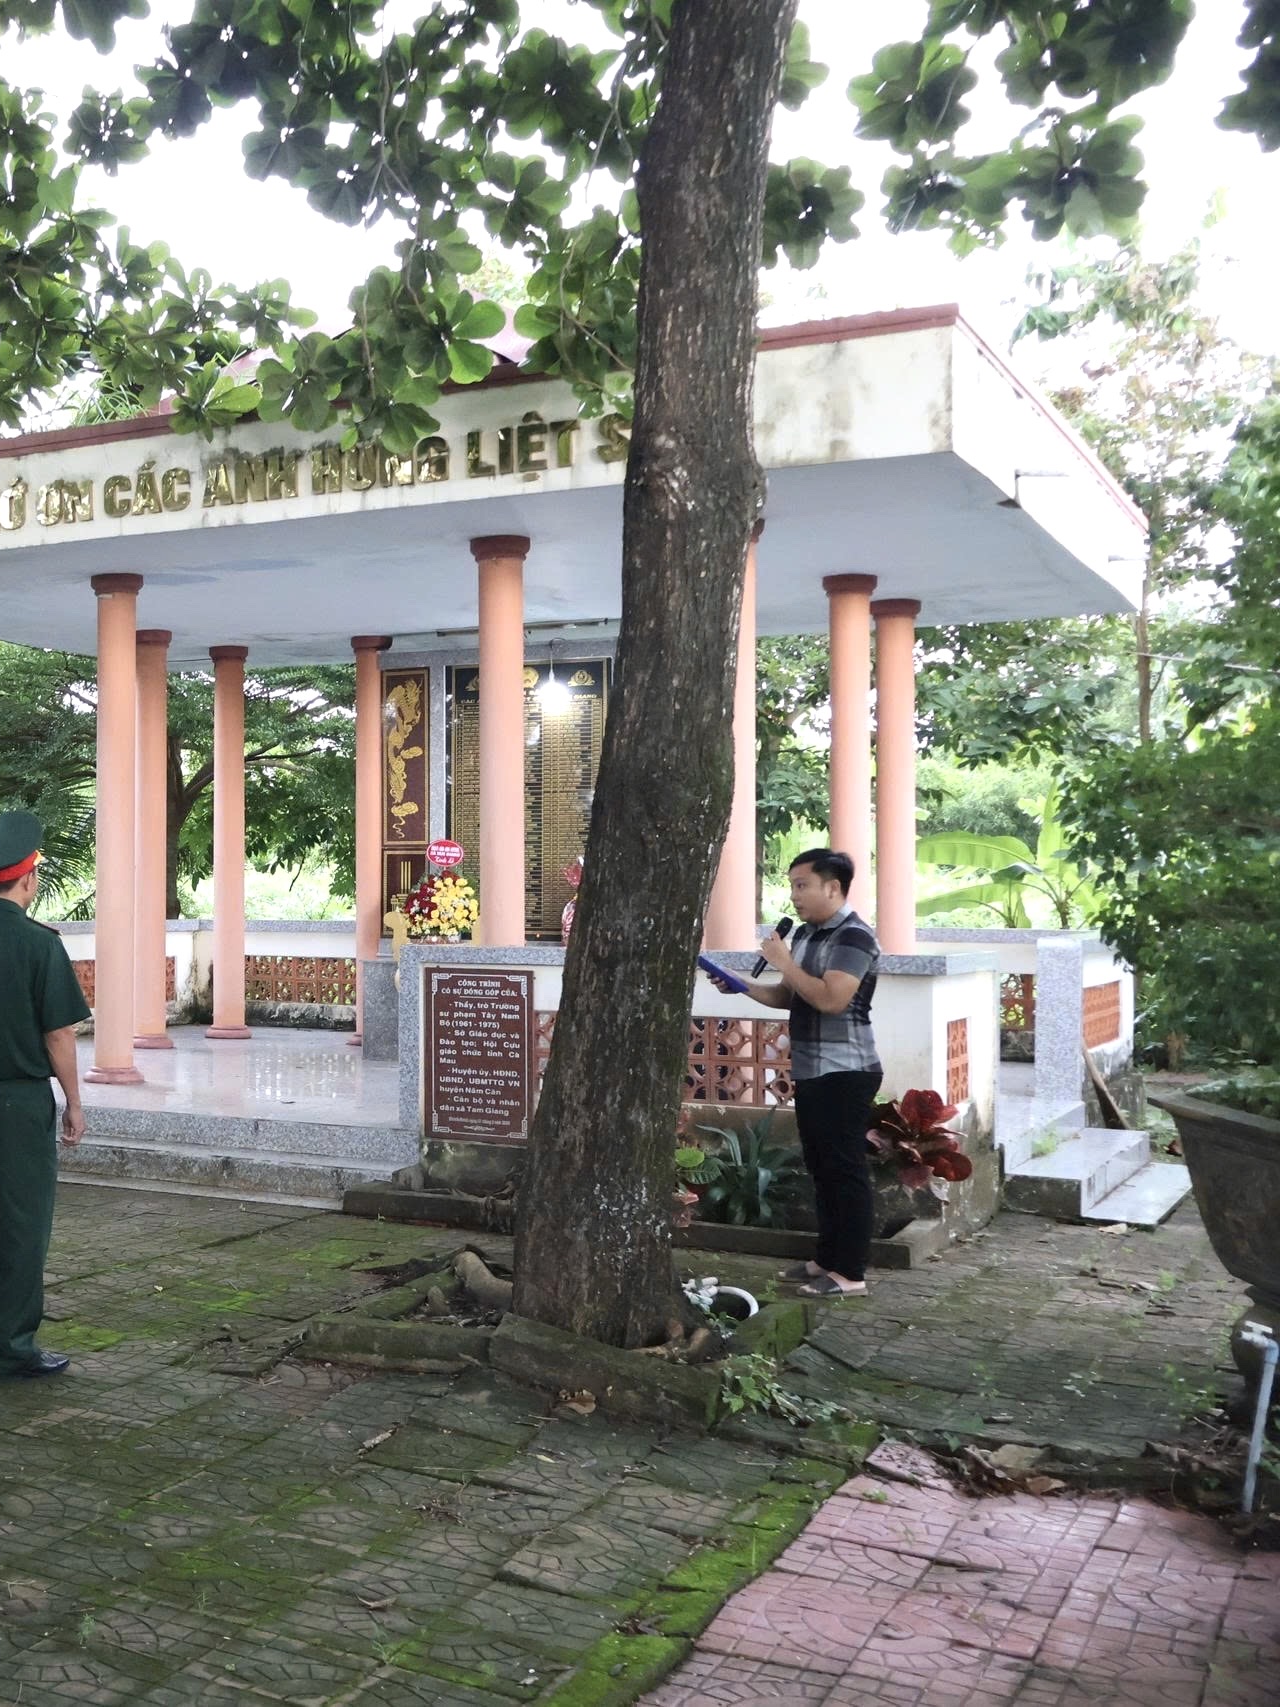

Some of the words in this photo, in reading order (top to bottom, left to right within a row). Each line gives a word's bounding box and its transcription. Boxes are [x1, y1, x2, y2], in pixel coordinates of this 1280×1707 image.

[36, 477, 95, 527] ƠN
[103, 459, 191, 518] CÁC
[202, 447, 299, 508] ANH
[466, 410, 581, 482] LIỆT
[596, 412, 633, 464] S
[480, 1021, 500, 1029] 1975)
[469, 1078, 504, 1086] UBMTTQ
[485, 1107, 509, 1116] Giang
